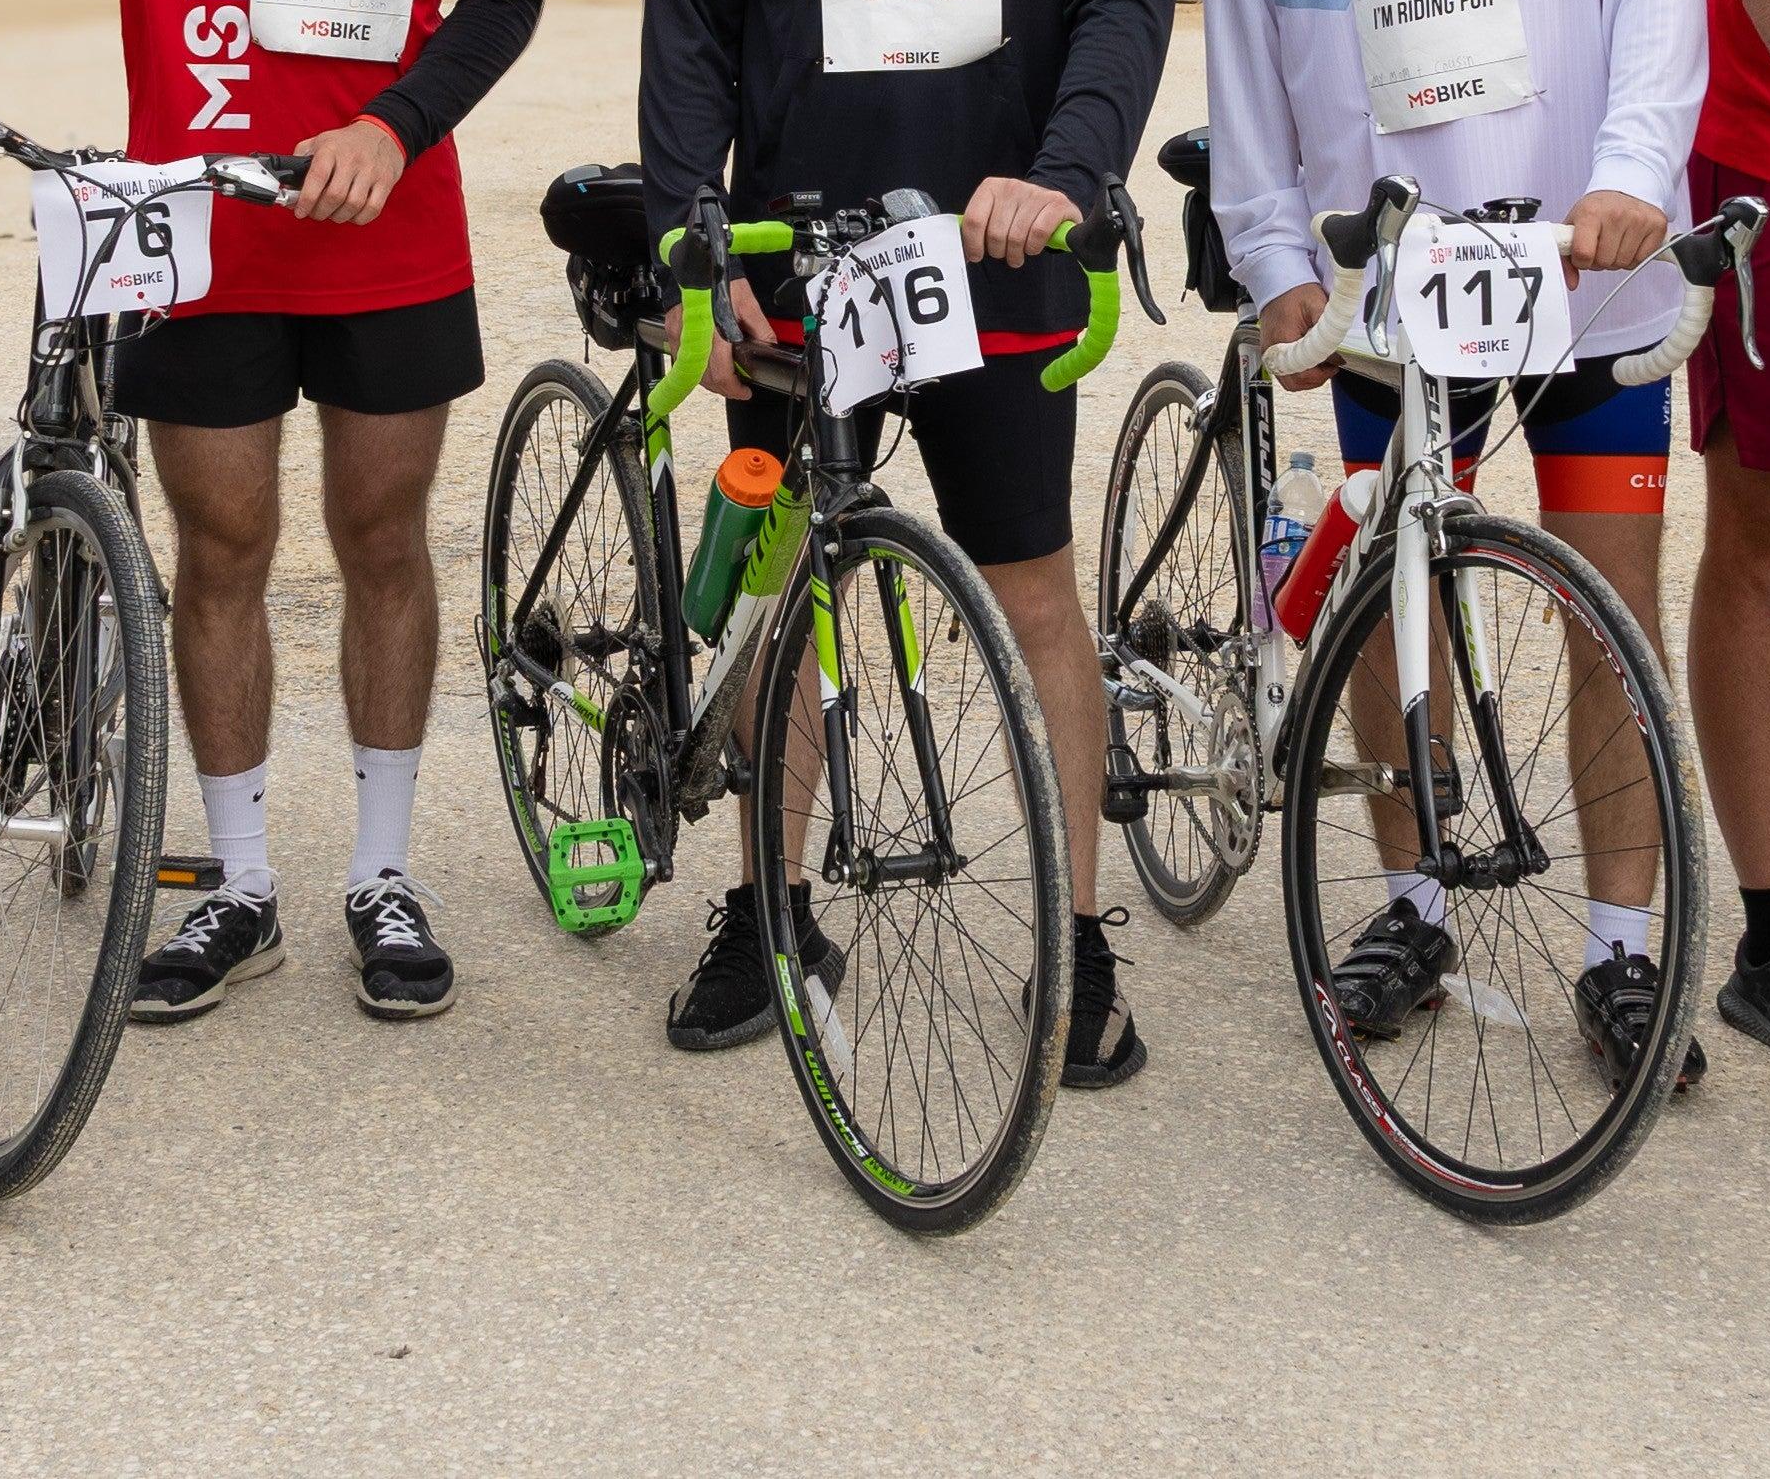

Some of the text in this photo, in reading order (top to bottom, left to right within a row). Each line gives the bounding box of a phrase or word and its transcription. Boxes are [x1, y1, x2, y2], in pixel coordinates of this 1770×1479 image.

[1373, 4, 1394, 30] I'M
[300, 20, 371, 41] MSBIKE
[883, 51, 940, 64] MSBIKE
[1407, 78, 1486, 109] MSBIKE
[101, 179, 147, 200] ANNUAL
[85, 202, 173, 264] 76
[850, 252, 894, 282] ANNUAL
[895, 241, 925, 264] GIMLI
[1429, 242, 1528, 264] 36TH ANNUAL GIMLI
[110, 271, 164, 289] MSBIKE
[838, 265, 950, 349] 116
[1419, 266, 1544, 331] 117
[1460, 339, 1510, 355] MSBIKE
[1256, 392, 1272, 492] FUJI
